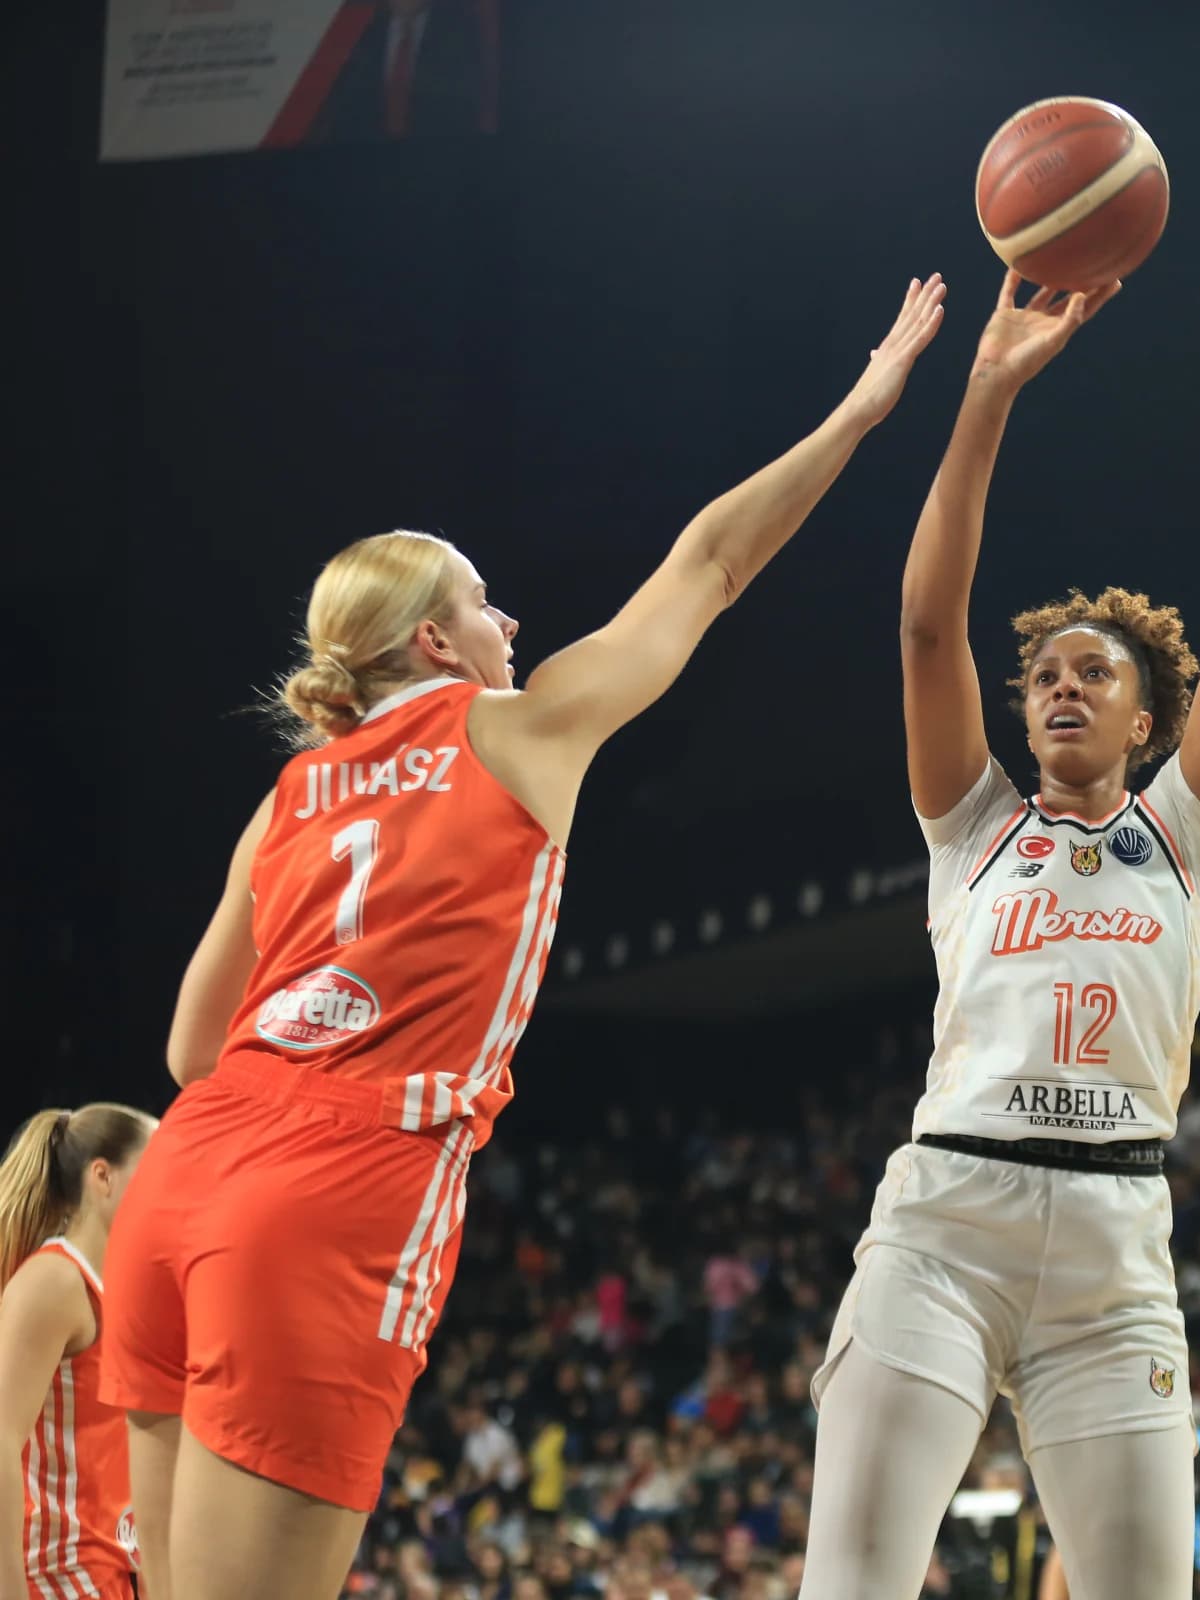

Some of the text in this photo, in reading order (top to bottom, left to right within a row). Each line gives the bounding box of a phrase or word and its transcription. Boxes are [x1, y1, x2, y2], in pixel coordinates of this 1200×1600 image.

[330, 818, 380, 946] 1
[990, 888, 1163, 957] Mersin
[1053, 982, 1118, 1065] 12
[1004, 1084, 1137, 1120] ARBELLA
[1031, 1116, 1116, 1131] MAKARNA
